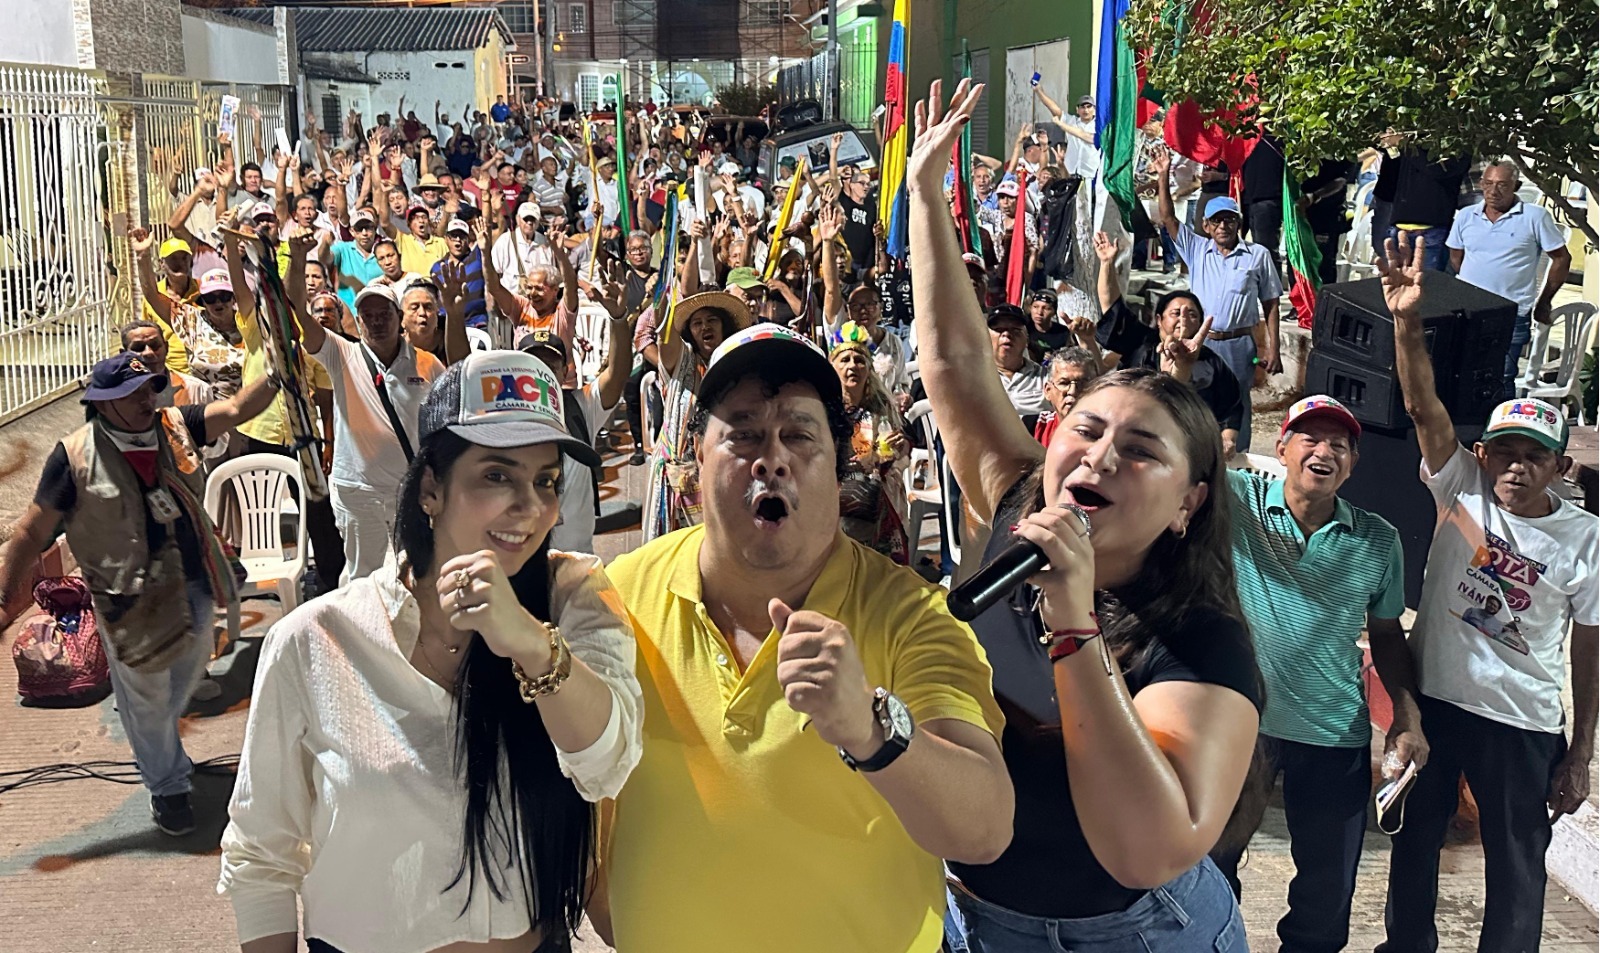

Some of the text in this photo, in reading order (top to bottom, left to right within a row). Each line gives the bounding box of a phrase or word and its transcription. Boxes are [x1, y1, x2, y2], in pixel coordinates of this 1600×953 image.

[495, 401, 530, 409] CÁMARA
[1466, 567, 1500, 594] CÁMARA
[1457, 581, 1486, 604] IVÁN
